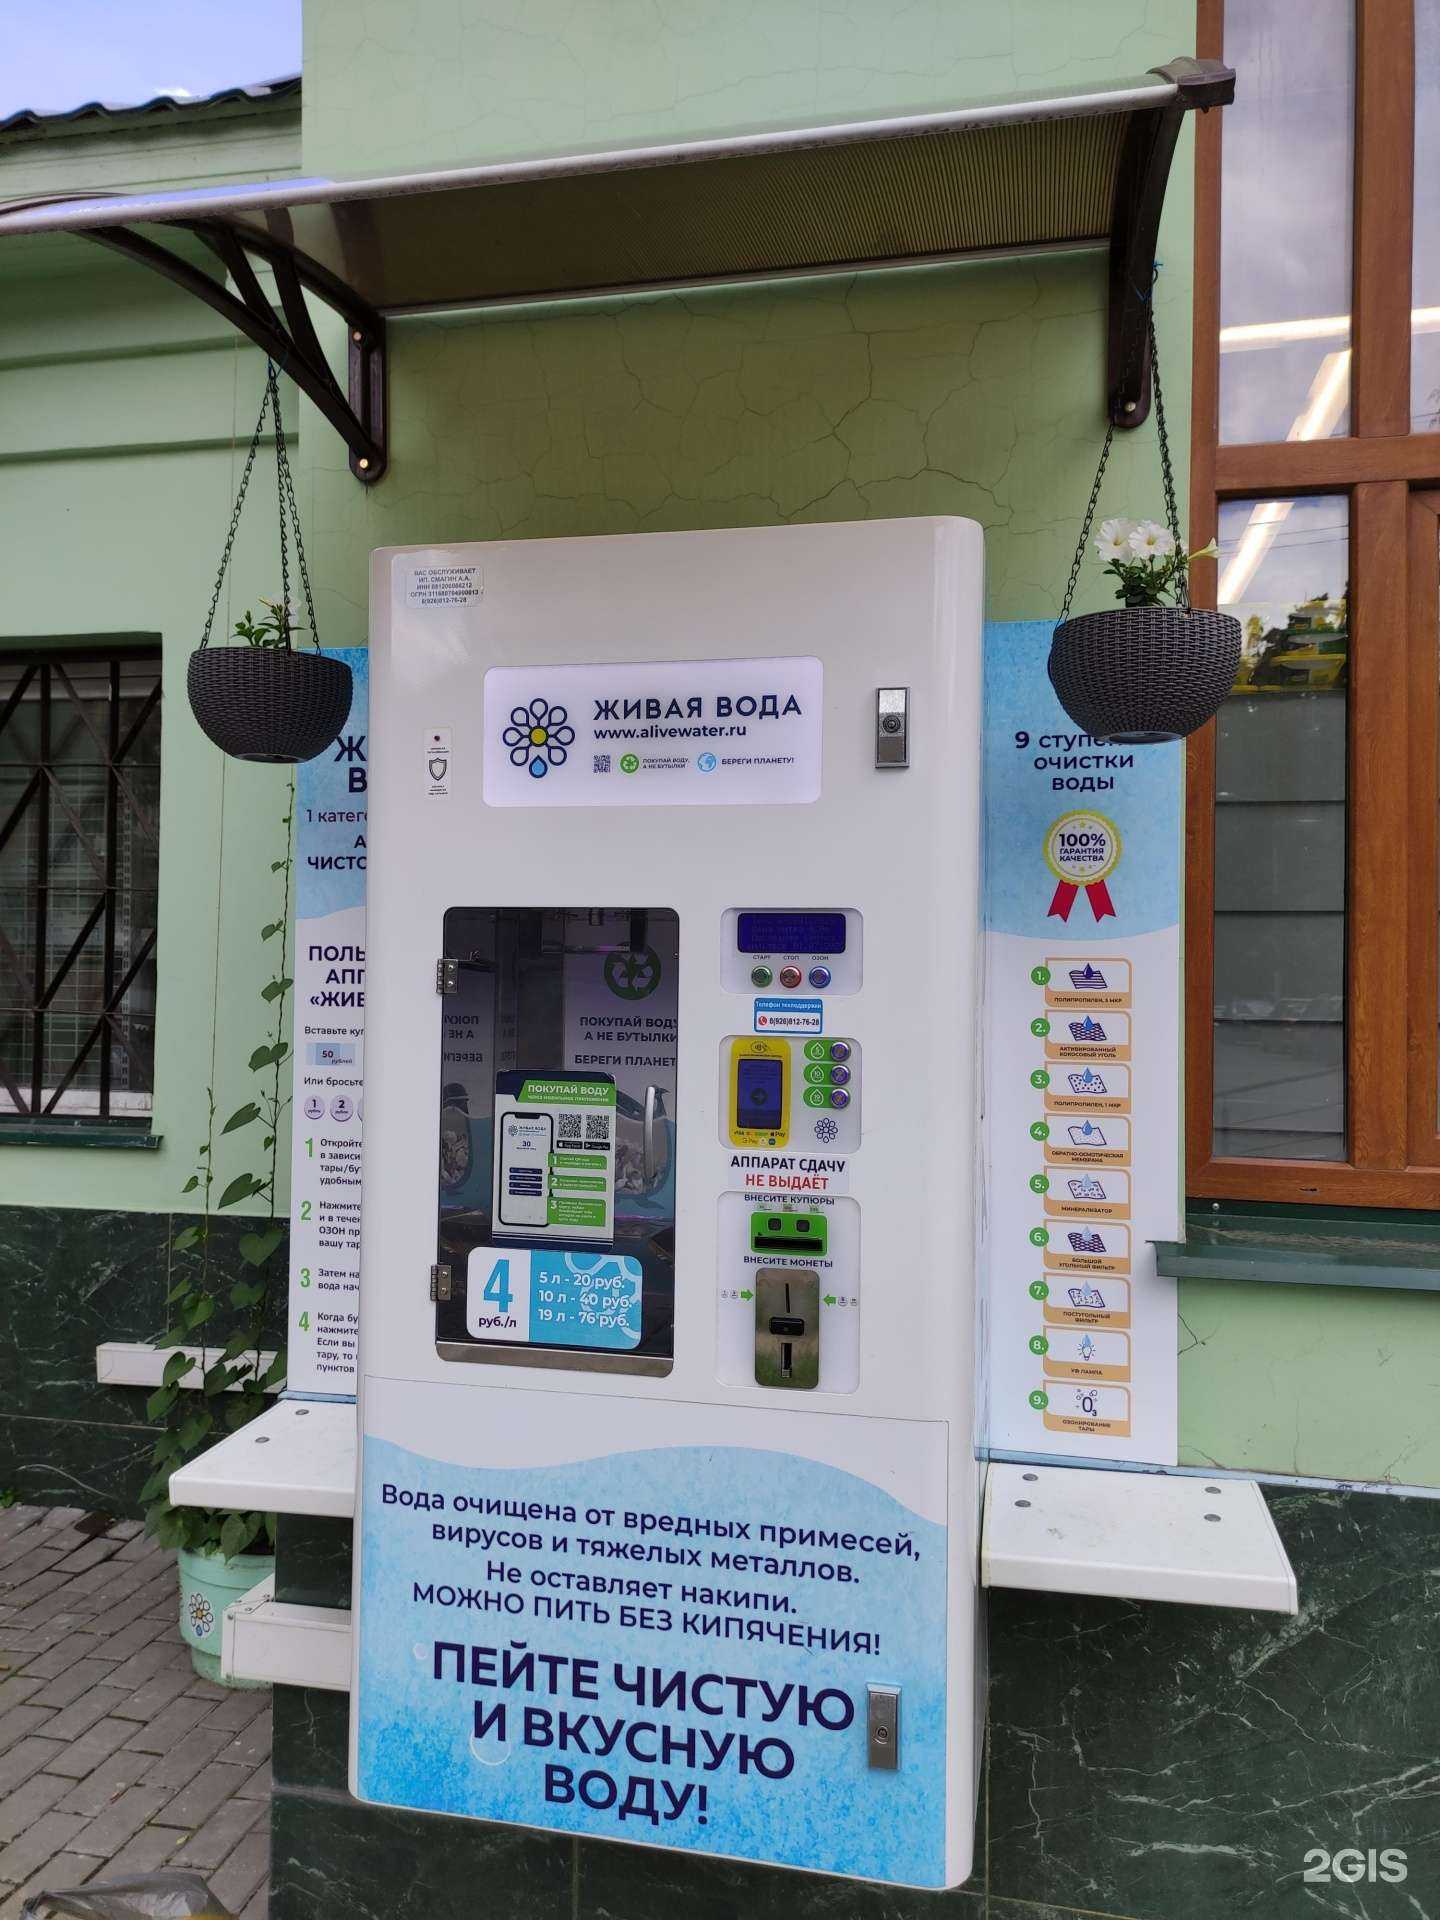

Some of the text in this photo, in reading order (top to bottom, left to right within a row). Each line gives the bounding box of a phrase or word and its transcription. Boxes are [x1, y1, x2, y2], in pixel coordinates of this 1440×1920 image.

[593, 695, 802, 720] ЖИВАЯ ВОДА
[594, 725, 747, 739] www.alivewater.ru
[1015, 731, 1030, 749] 9
[753, 757, 794, 765] ПЛАНЕТУ!
[1034, 755, 1134, 770] очистки
[1052, 776, 1114, 793] воды
[306, 809, 313, 822] 1
[1059, 833, 1106, 848] 100%
[579, 1016, 642, 1027] ПОКУПАЙ
[304, 1026, 348, 1035] Вставьте
[1035, 1023, 1046, 1033] 2.
[584, 1031, 677, 1043] А НЕ БУТЫЛКИ
[322, 1050, 334, 1058] 50
[574, 1054, 622, 1065] БЕРЕГИ
[304, 1076, 324, 1085] Или
[1035, 1074, 1046, 1085] 3.
[527, 1084, 609, 1097] ПОКУПАЙ ВОДУ
[312, 1099, 317, 1108] 1
[338, 1099, 345, 1109] 2
[1035, 1126, 1046, 1137] 4.
[304, 1137, 313, 1158] 1
[552, 1154, 557, 1165] 1
[730, 1155, 846, 1174] АППАРАТ СДАЧУ
[320, 1176, 362, 1186] удобным
[551, 1177, 558, 1187] 2
[745, 1173, 829, 1191] НЕ ВЫДАЁТ
[1035, 1179, 1046, 1190] 5.
[550, 1200, 558, 1210] 3
[744, 1193, 835, 1206] ВНЕСИТЕ КУПЮРЫ
[301, 1200, 312, 1221] 2
[1061, 1206, 1113, 1214] МИНЕРАЛИЗАТОР
[318, 1226, 346, 1236] ОЗОН
[1035, 1232, 1045, 1243] 6.
[318, 1239, 344, 1250] вашу
[743, 1256, 833, 1268] ВНЕСИТЕ МОНЕТЫ
[300, 1267, 311, 1288] 3
[318, 1268, 347, 1278] Затем
[538, 1271, 626, 1289] 5 л 20 руб.
[318, 1282, 341, 1291] вода
[483, 1258, 513, 1313] 4
[1034, 1285, 1045, 1296] 7.
[538, 1289, 633, 1309] 10 л 40 руб.
[298, 1310, 310, 1332] 4
[317, 1312, 345, 1322] Когда
[478, 1315, 518, 1328] руб./л
[538, 1308, 630, 1329] 19 л 76 руб.
[317, 1326, 359, 1336] нажмите
[317, 1337, 355, 1348] Если вы
[1034, 1341, 1045, 1351] 8.
[316, 1351, 353, 1361] тару, то
[316, 1363, 355, 1374] пунктов
[1034, 1395, 1045, 1406] 9.
[381, 1483, 921, 1562] Вода очищена от вредных примесей,
[432, 1523, 860, 1584] вирусов и тяжелых металлов.
[487, 1560, 797, 1614] Не оставляет накипи.
[413, 1582, 881, 1656] МОЖНО ПИТЬ БЕЗ КИПЯЧЕНИЯ!
[433, 1639, 855, 1732] ПЕЙТЕ ЧИСТУЮ
[474, 1700, 796, 1780] И ВКУСНУЮ
[544, 1763, 709, 1826] ВОДУ!
